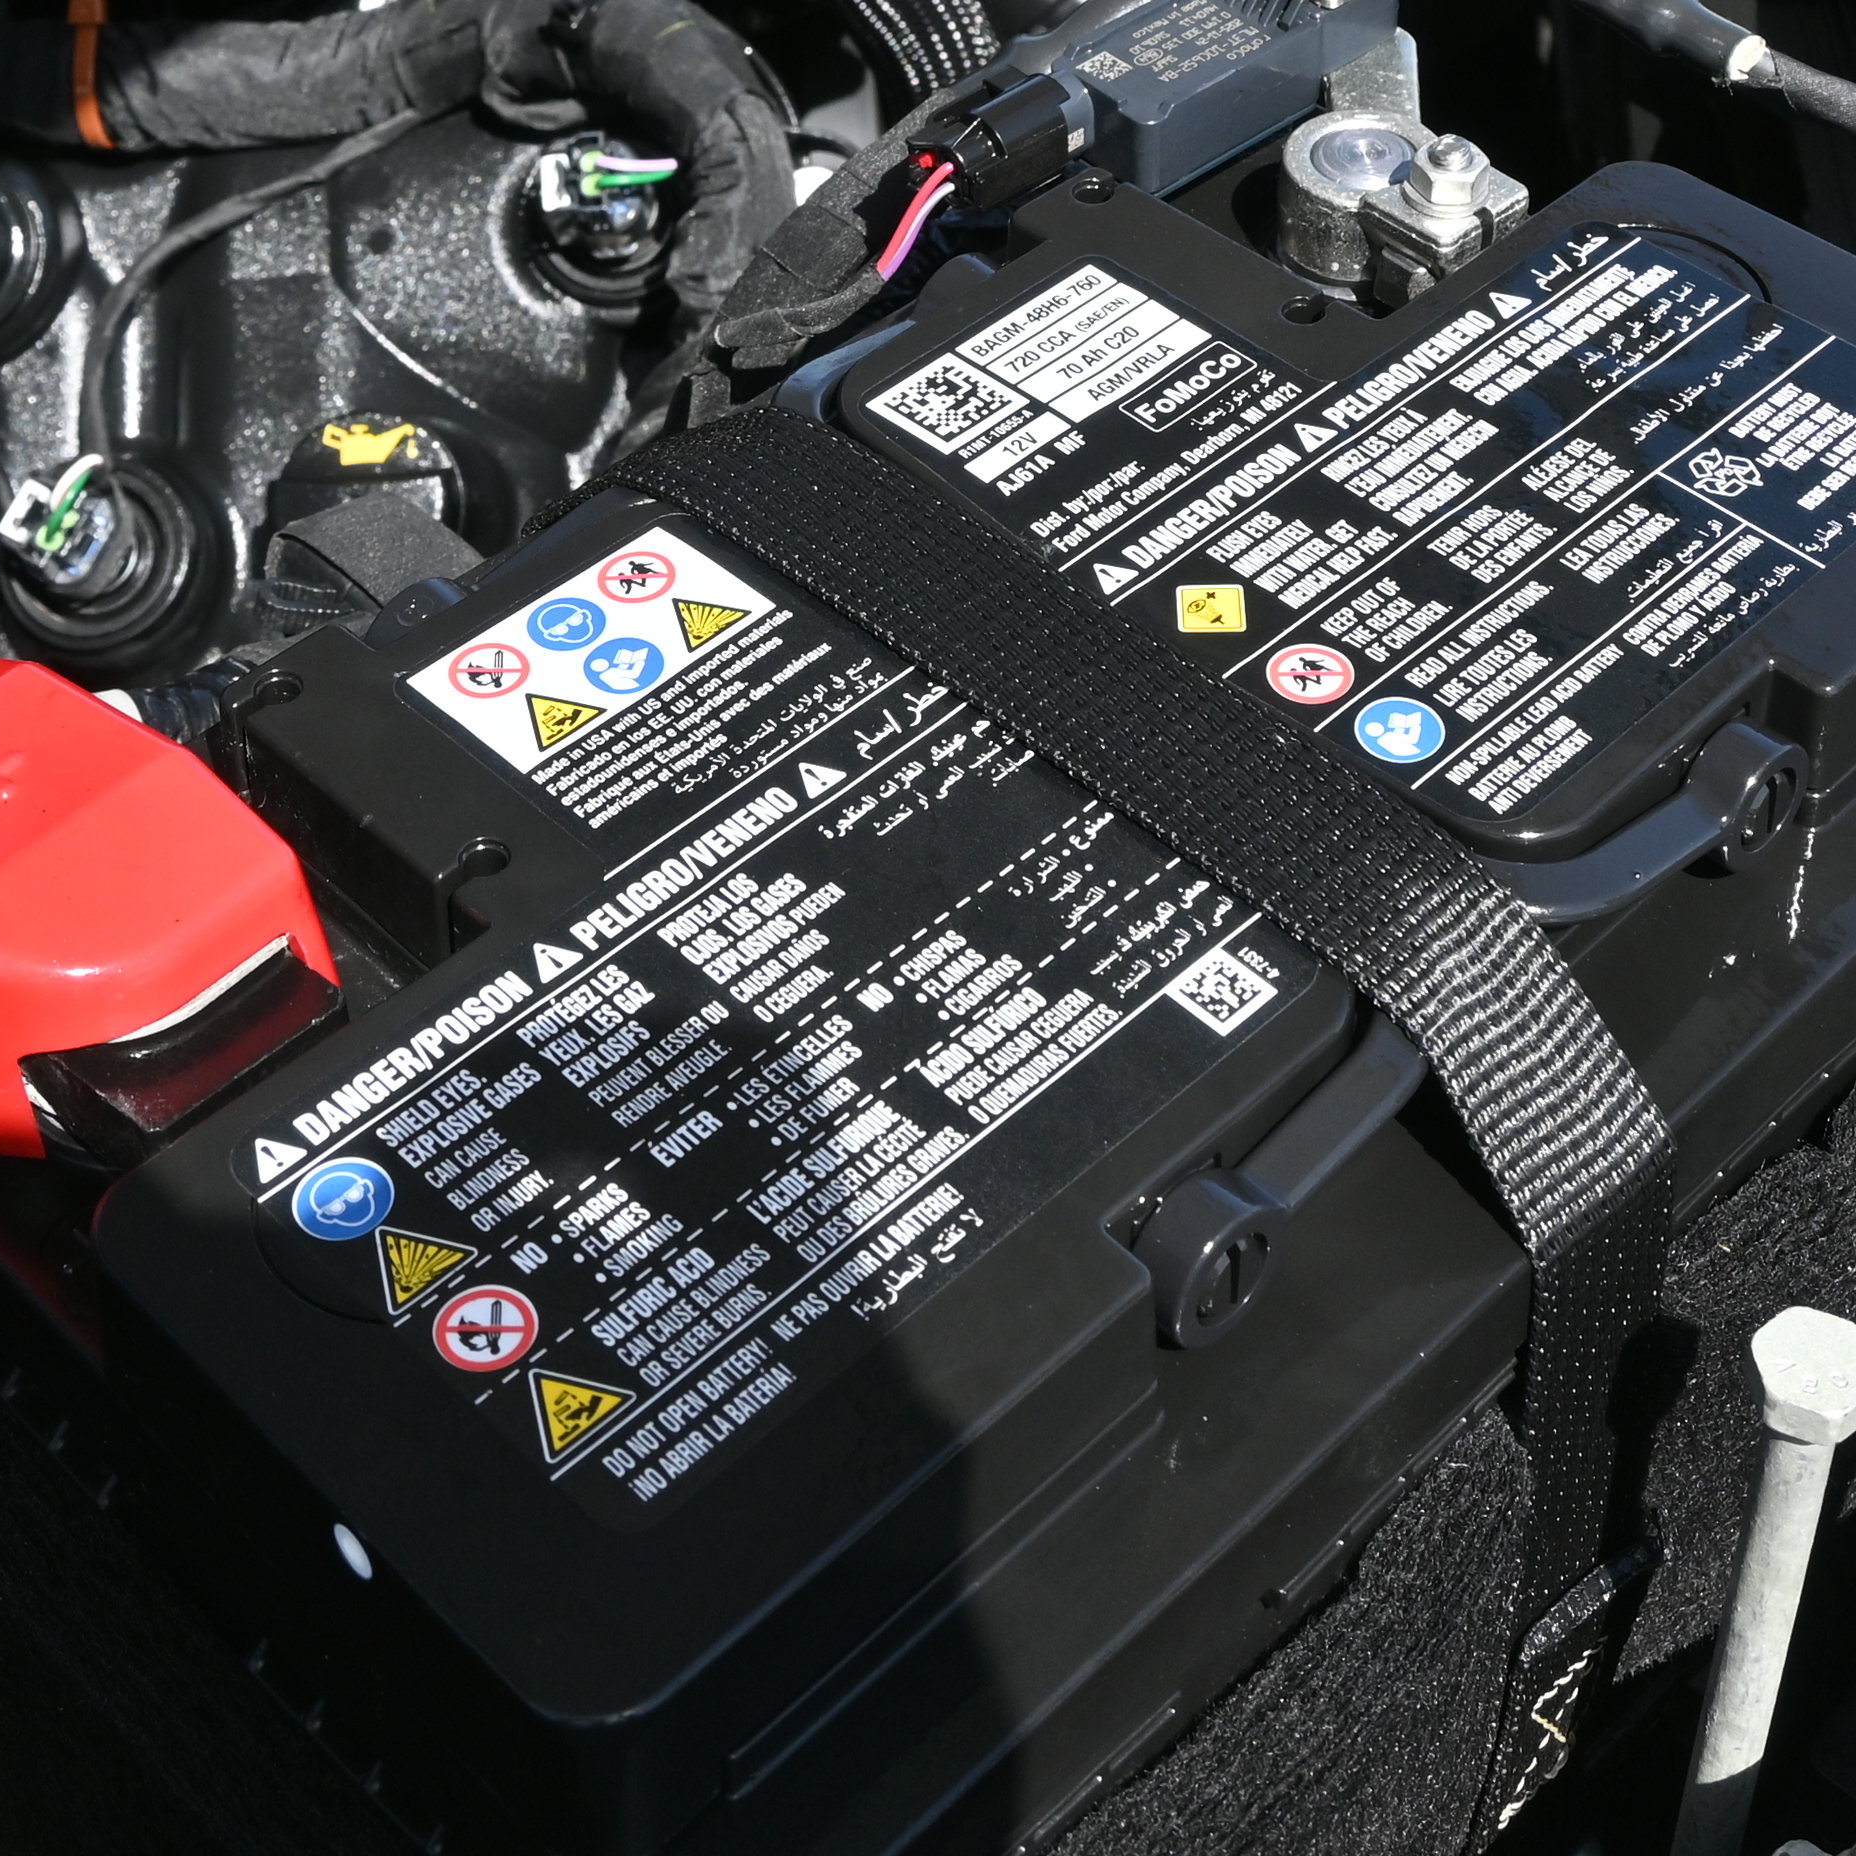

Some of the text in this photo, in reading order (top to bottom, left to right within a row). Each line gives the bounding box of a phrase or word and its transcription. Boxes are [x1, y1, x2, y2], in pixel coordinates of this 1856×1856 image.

[1131, 17, 1168, 38] Mexico
[1166, 10, 1178, 19] in
[970, 274, 1101, 356] BAGM-48H6-760
[1004, 297, 1129, 372] 720 CCA (SAE/EN)
[1055, 326, 1139, 378] 70 Ah C20
[1087, 344, 1174, 401] AGM/VRLA
[1133, 353, 1241, 423] FoMoCo
[1321, 309, 1495, 429] PELIGRO/VENENO
[995, 430, 1085, 496] AJ61A MF
[1002, 431, 1037, 456] 12V
[1051, 381, 1302, 552] Ford Motor Company, Dearborn, MI 48121
[1029, 510, 1070, 537] Dist.
[1121, 443, 1301, 568] DANGER/POISON
[530, 609, 793, 784] Made in USA with US and imported materials
[545, 636, 783, 796] Fabricado en los EE. UU. con materiales
[572, 642, 832, 818] Fabriqué aux États-Unis avec des matériaux
[560, 680, 748, 806] estadounidenses e importados.
[588, 733, 727, 828] américains et importés
[569, 786, 797, 950] PELIGRO/VENENO
[656, 872, 758, 947] PROTEJA LOS
[680, 872, 806, 965] OJOS. LOS GASES
[702, 881, 845, 984] EXPLOSIVOS PUEDEN
[729, 928, 829, 1003] CAUSAR DAÑOS
[753, 965, 834, 1022] O CEGUERA.
[899, 929, 966, 981] CHISPAS
[920, 947, 986, 999] FLAMAS
[944, 953, 1022, 1015] CIGARROS
[515, 964, 629, 1047] PROTÉGEZ LES
[538, 980, 655, 1065] YEUX. LES GAZ
[856, 982, 893, 1012] NO
[914, 986, 1046, 1087] ÁCIDO SULFÚRICO
[292, 970, 533, 1145] DANGER/POISON
[561, 1020, 650, 1087] EXPLOSIFS
[587, 1000, 729, 1107] PEUVENT BLESSER OU
[733, 1014, 853, 1105] LES ÉTINCELLES
[755, 1040, 862, 1123] LES FLAMMES
[943, 988, 1094, 1105] PUEDE CAUSAR CEGUERA
[375, 1069, 487, 1147] SHIELD EYES.
[397, 1062, 541, 1168] EXPLOSIVE GASES
[647, 1110, 723, 1167] ÉVITER
[777, 1076, 860, 1140] DE FUMER
[802, 1099, 905, 1178] SULFURIQUE
[424, 1127, 506, 1188] CAN CAUSE
[446, 1148, 529, 1210] BLINDNESS
[772, 1117, 926, 1243] PEUT CAUSER LA CÉCITÉ
[796, 1125, 969, 1262] OU DES BRÛLURES GRAVES.
[470, 1169, 554, 1231] OR INJURY.
[559, 1182, 628, 1237] SPARKS
[580, 1201, 650, 1257] FLAMES
[509, 1241, 548, 1273] NO
[603, 1213, 683, 1276] SMOKING
[770, 1182, 964, 1341] NE PAS OUVRIR LA BATTERIE!
[591, 1247, 714, 1346] SULFURIC ACID
[616, 1243, 770, 1366] CAN CAUSE BLINDNESS
[639, 1283, 771, 1386] OR SEVERE BURNS.
[602, 1337, 772, 1477] DO NOT OPEN BATTERY!
[628, 1362, 796, 1501] ¡NO ABRIR LA BATERÍA!
